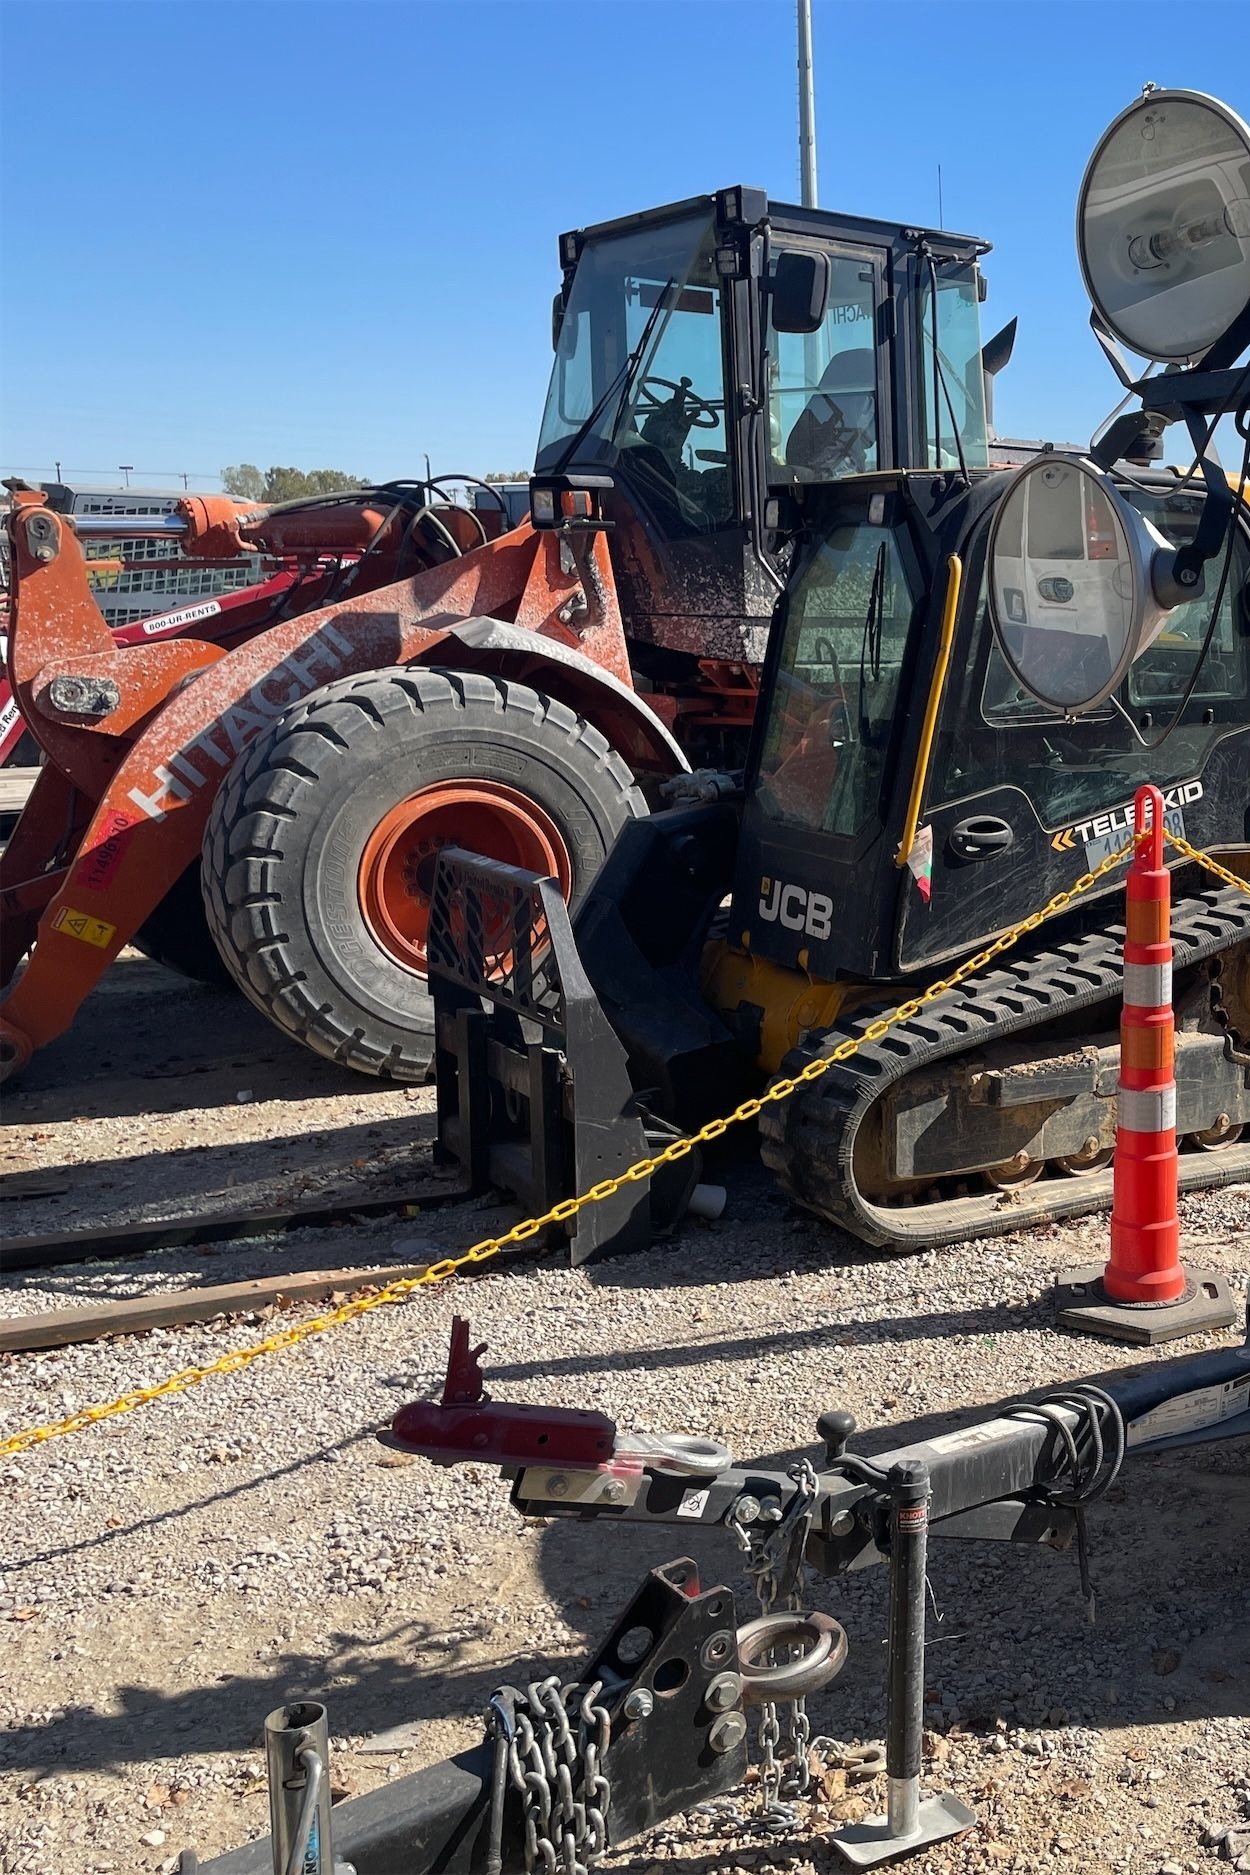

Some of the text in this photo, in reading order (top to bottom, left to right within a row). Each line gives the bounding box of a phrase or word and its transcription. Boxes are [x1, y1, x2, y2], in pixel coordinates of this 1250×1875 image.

[149, 604, 217, 631] 800-UR-RENTS
[127, 622, 355, 824] HITACHI
[759, 880, 833, 940] JCB
